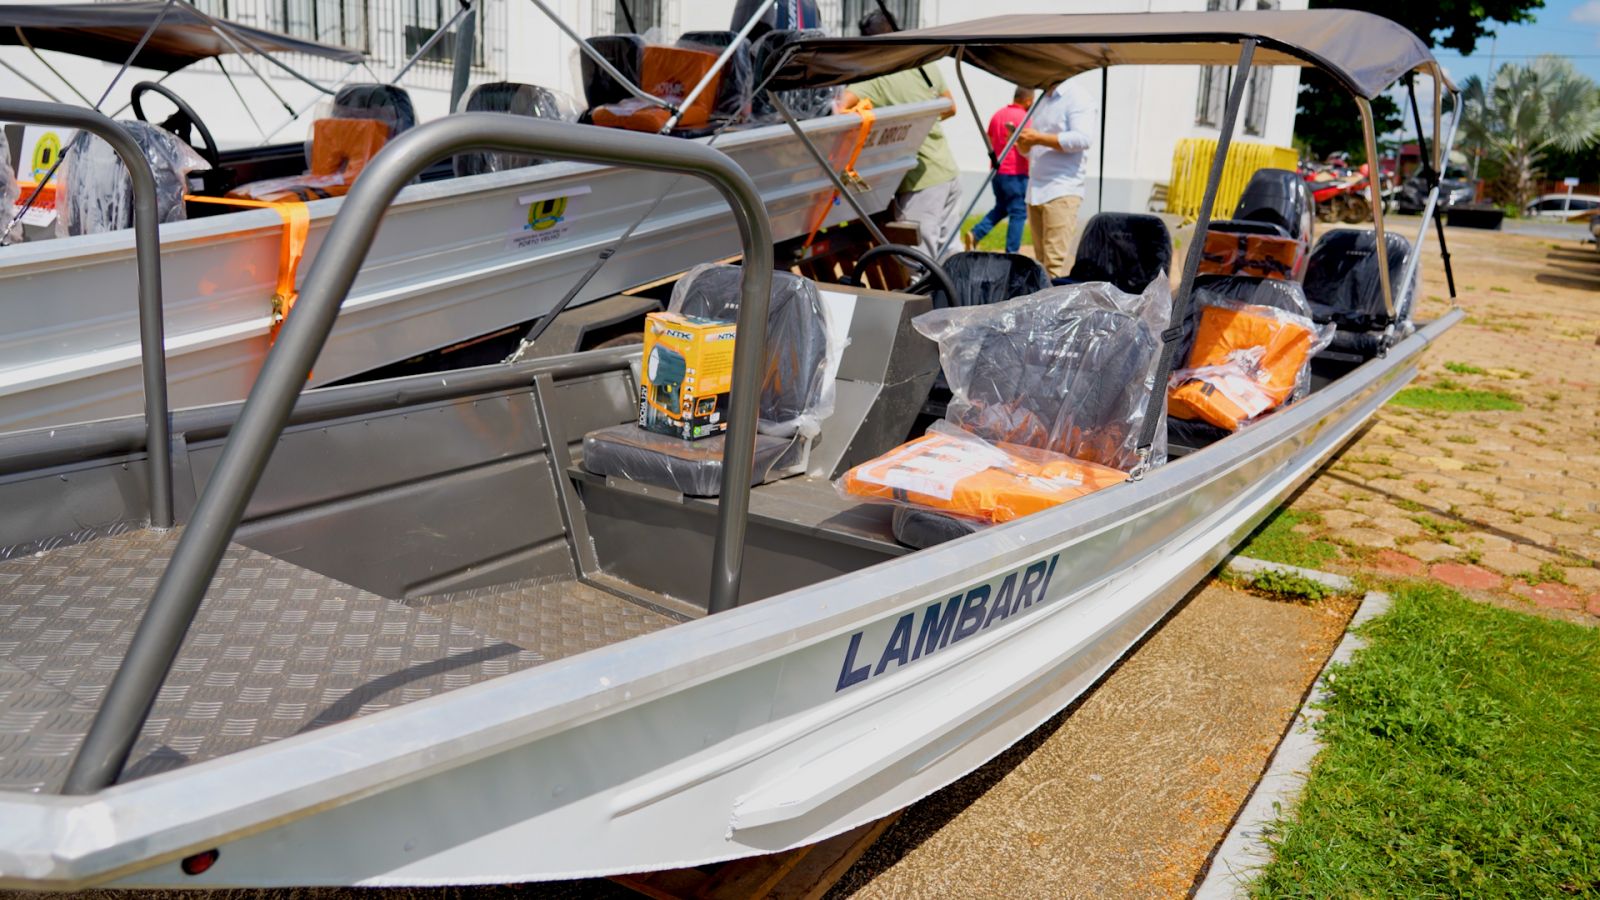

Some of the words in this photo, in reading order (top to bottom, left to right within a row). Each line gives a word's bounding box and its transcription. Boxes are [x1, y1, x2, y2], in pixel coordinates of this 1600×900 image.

[666, 329, 691, 340] NTK
[718, 332, 735, 340] NTK
[836, 553, 1060, 693] LAMBARI
